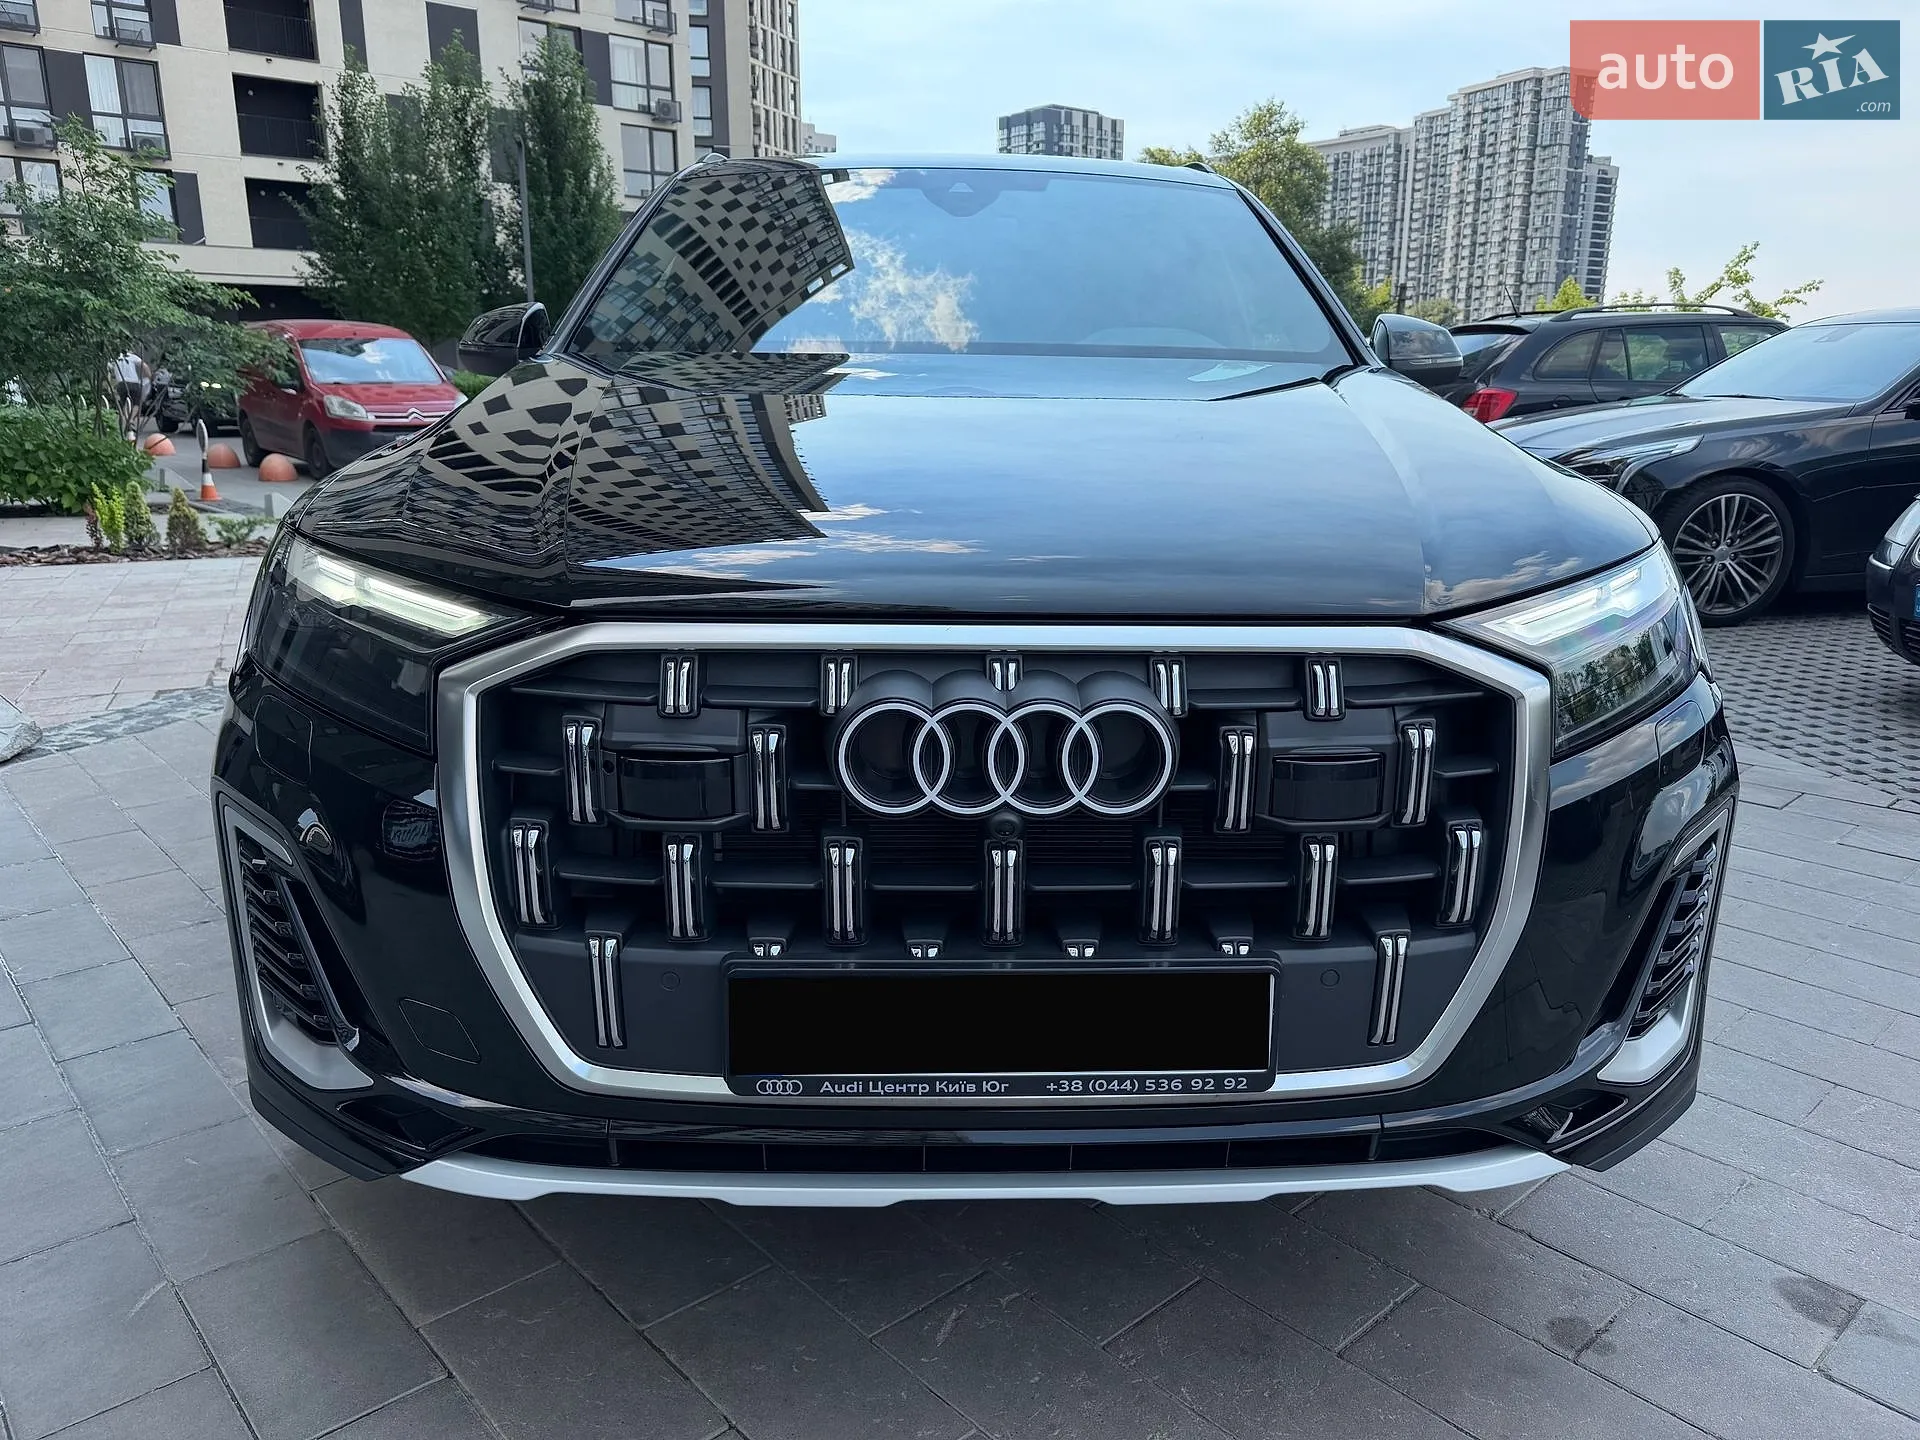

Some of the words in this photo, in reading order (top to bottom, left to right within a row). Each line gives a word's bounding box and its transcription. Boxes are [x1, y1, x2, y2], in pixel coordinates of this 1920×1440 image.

[820, 1081, 863, 1093] Audi
[869, 1081, 929, 1095] Центр
[936, 1080, 977, 1093] Київ
[982, 1080, 1009, 1093] Юг
[1046, 1079, 1083, 1092] +38
[1088, 1079, 1139, 1093] (044)
[1145, 1078, 1183, 1091] 536
[1190, 1078, 1215, 1091] 92
[1223, 1077, 1248, 1090] 92
